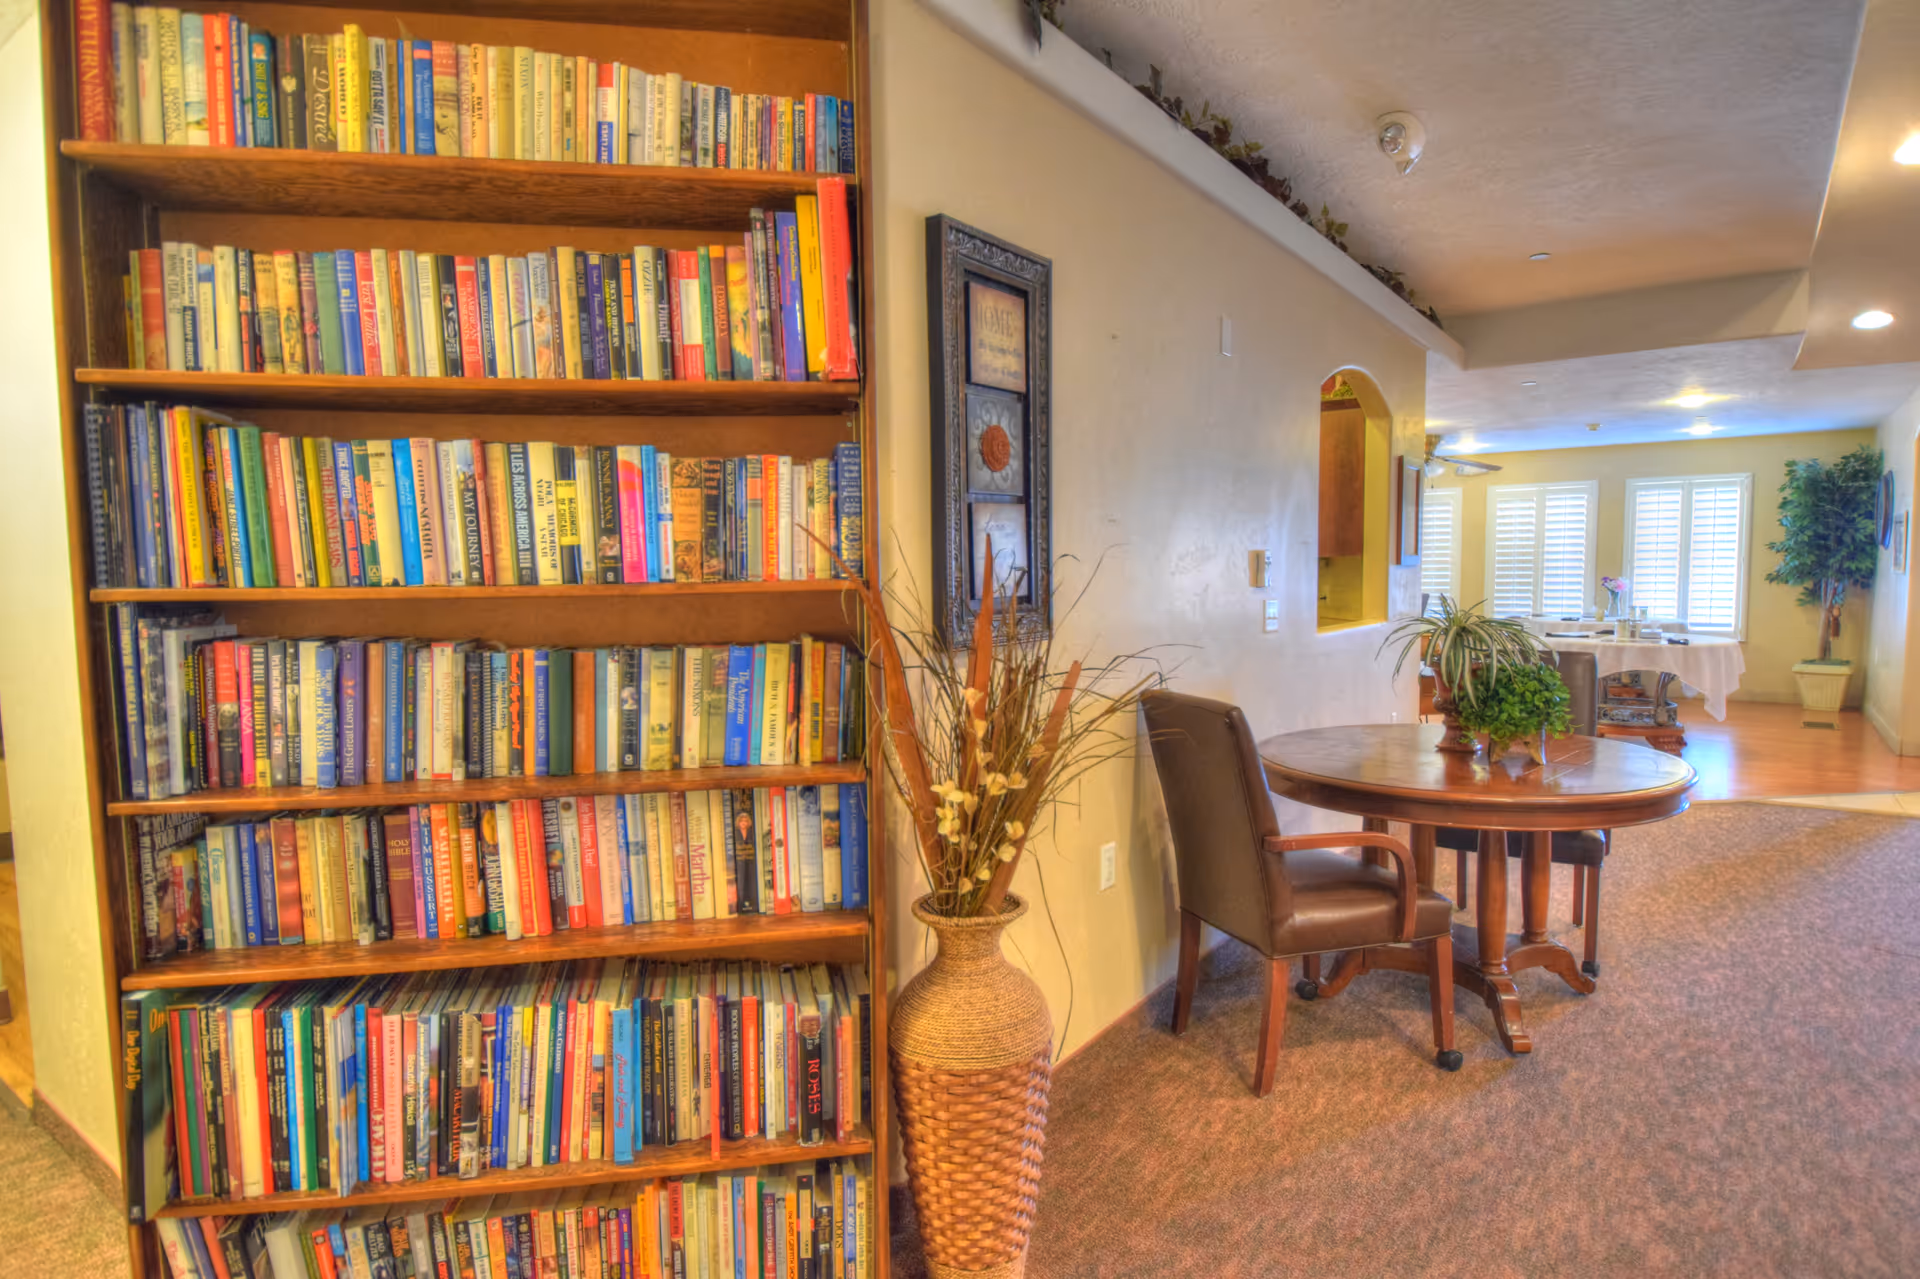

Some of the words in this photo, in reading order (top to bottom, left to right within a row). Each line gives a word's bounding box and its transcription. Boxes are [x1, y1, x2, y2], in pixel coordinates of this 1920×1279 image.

[79, 29, 98, 83] TURN
[519, 56, 529, 88] NIXON
[372, 98, 384, 115] SAY
[372, 117, 384, 126] IT
[608, 280, 617, 301] TRACY
[641, 258, 653, 297] OZZIE
[360, 281, 376, 306] First
[715, 285, 727, 327] EDWARD
[184, 309, 194, 340] TAMMY
[362, 309, 378, 347] Ladies
[466, 295, 477, 340] AMERICAN
[185, 341, 194, 367] BRUCE
[336, 447, 347, 468] TWICE
[511, 454, 524, 474] LIES
[321, 466, 337, 491] THE
[338, 470, 350, 498] ADOPTED
[512, 475, 527, 510] ACROSS
[536, 479, 546, 508] NEGRI
[544, 481, 554, 505] POLA
[325, 493, 339, 532] DIONNE
[462, 492, 475, 511] MY
[603, 496, 615, 530] NANCY
[515, 511, 531, 551] AMERICA
[559, 509, 568, 538] CHICAGO
[566, 498, 578, 538] McCORMICK
[419, 508, 434, 560] NOSTALGIA
[464, 513, 482, 569] JOURNEY
[546, 513, 556, 556] MEMOIRS
[329, 535, 345, 568] YEARS
[692, 657, 702, 677] THE
[738, 669, 749, 685] The
[691, 679, 702, 717] NIXONS
[727, 676, 739, 713] Presidents
[736, 687, 750, 725] American
[241, 700, 255, 735] LANZA
[316, 697, 325, 730] HOUSE
[537, 713, 546, 741] LADIES
[287, 738, 295, 763] LEIGH
[294, 736, 302, 764] WENDY
[316, 731, 326, 758] YEARS
[324, 724, 335, 753] WHITE
[544, 800, 561, 843] HERSHEY
[486, 855, 500, 877] JOHN
[690, 844, 711, 896] Martha
[424, 858, 438, 921] RUSSERT
[556, 871, 565, 898] MICHAEL
[730, 1009, 738, 1029] BOOK
[126, 1030, 140, 1046] One
[124, 1047, 141, 1074] Digital
[703, 1053, 712, 1089] CHICAGO
[731, 1041, 739, 1072] PEOPLES
[124, 1074, 141, 1090] Day
[406, 1054, 416, 1092] Beautiful
[807, 1057, 821, 1114] ROSES
[406, 1096, 416, 1126] Hawaii
[452, 1088, 463, 1163] MACARTHUR
[371, 1108, 385, 1178] CHICAGO
[835, 1220, 844, 1249] DOGS
